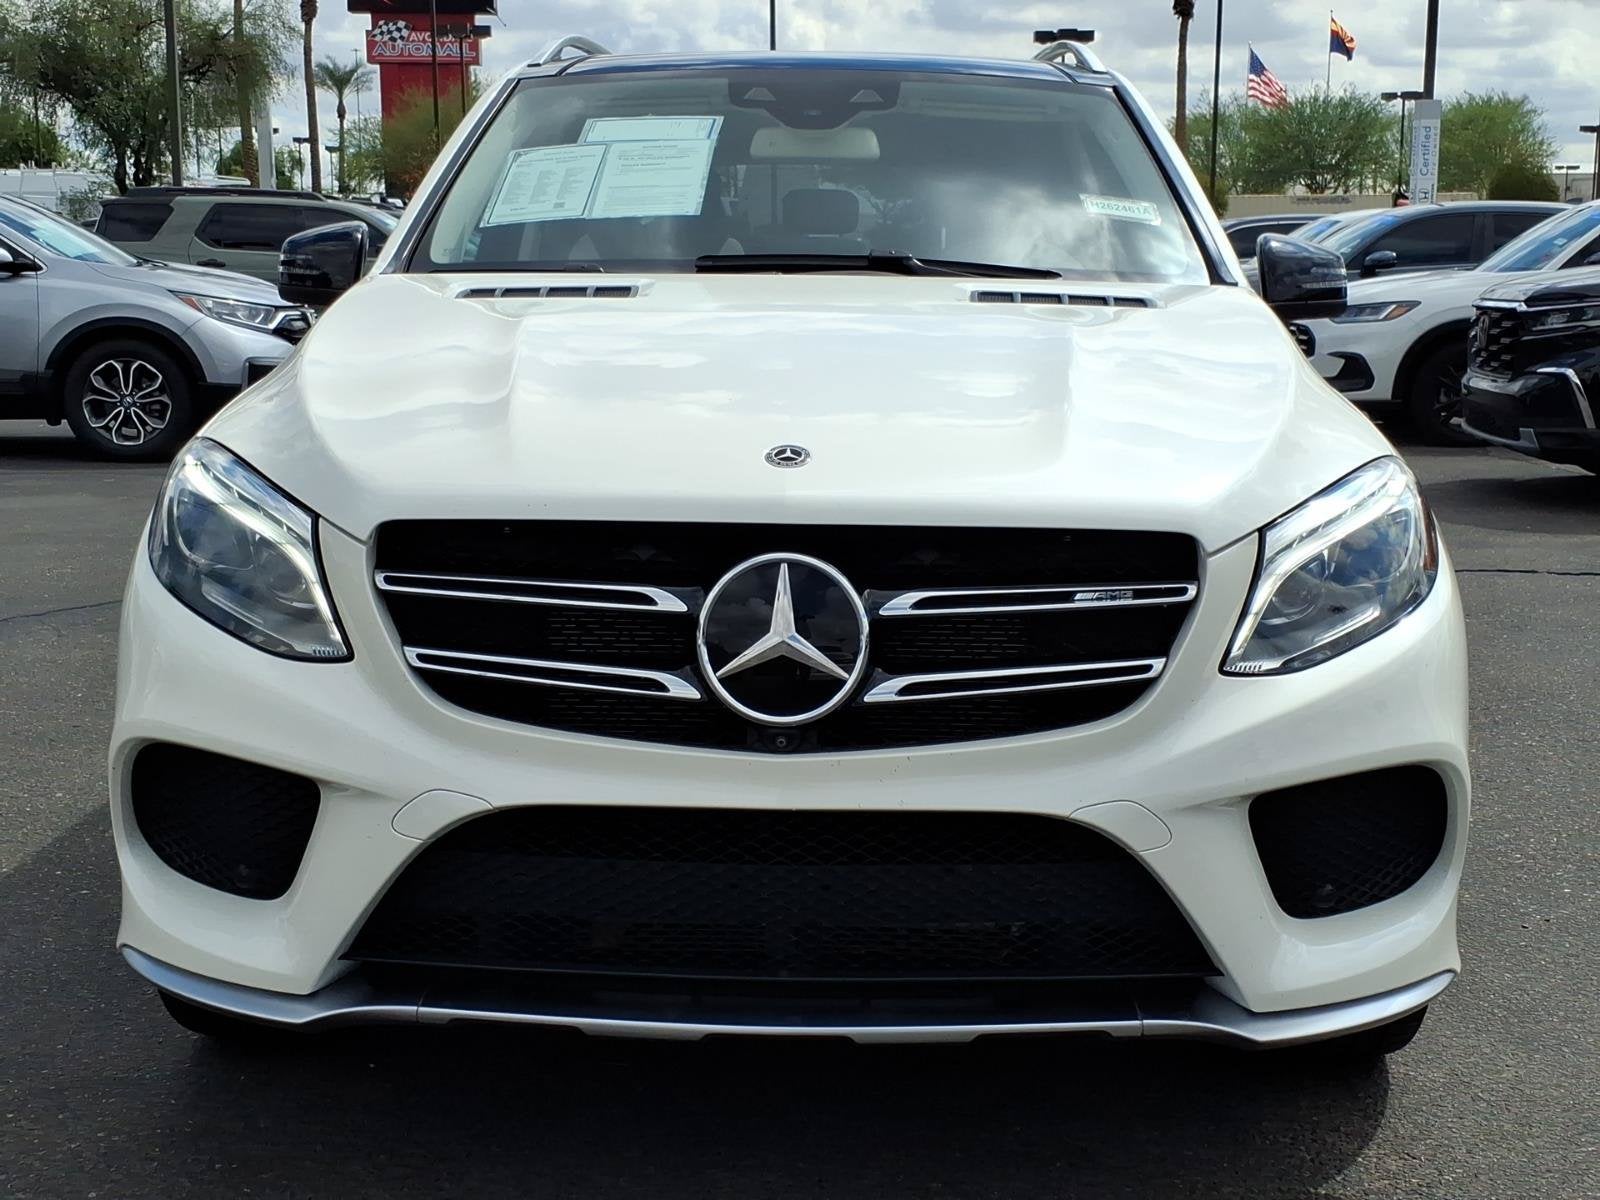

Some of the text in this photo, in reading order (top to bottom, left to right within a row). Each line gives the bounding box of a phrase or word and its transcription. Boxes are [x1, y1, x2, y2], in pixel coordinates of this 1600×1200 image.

[372, 42, 476, 56] AUTOMALL
[1420, 126, 1432, 176] Certified
[1095, 590, 1134, 599] AMG
